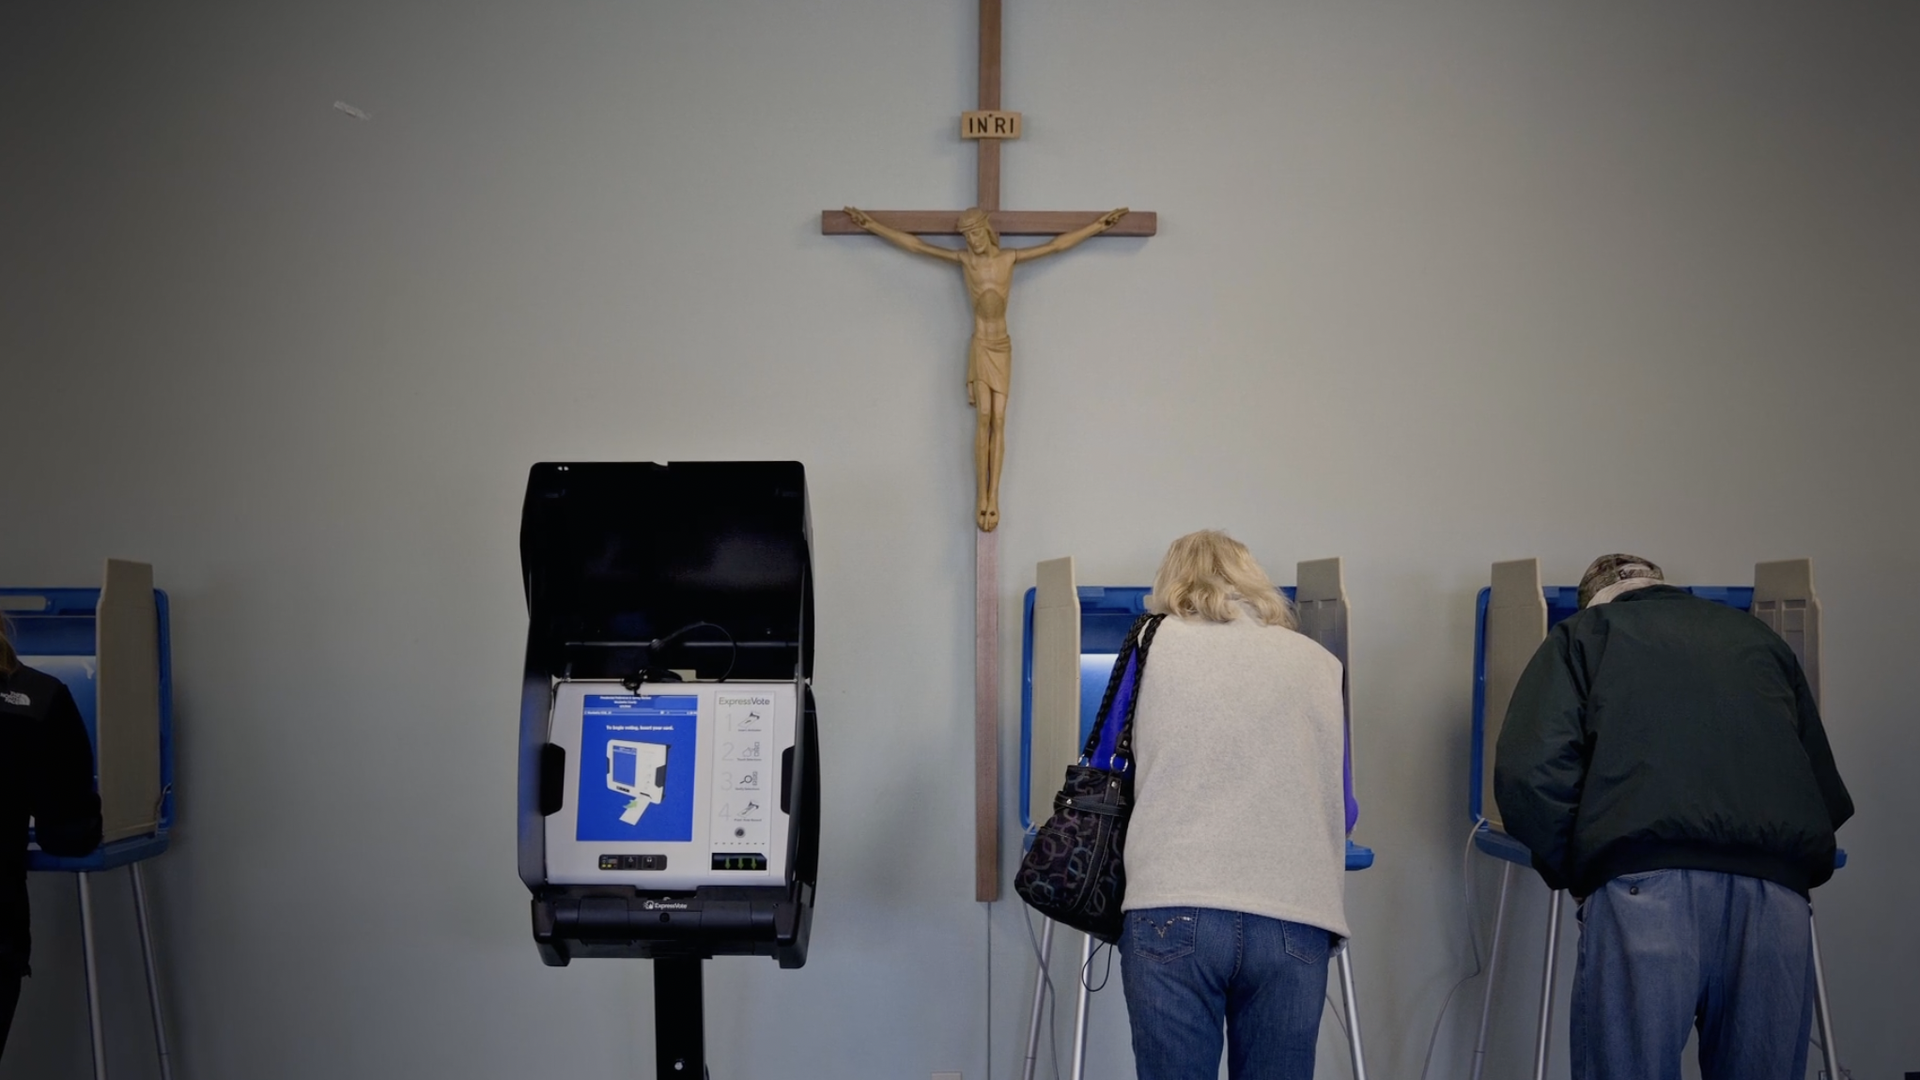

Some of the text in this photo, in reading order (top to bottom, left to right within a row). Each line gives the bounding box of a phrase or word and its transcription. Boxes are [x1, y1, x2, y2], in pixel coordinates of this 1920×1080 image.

[969, 117, 1014, 134] INRI
[718, 697, 770, 707] ExpressVote
[722, 741, 734, 761] 2
[720, 771, 733, 791] 3
[718, 803, 731, 821] 4
[654, 902, 688, 910] ExpressVote
